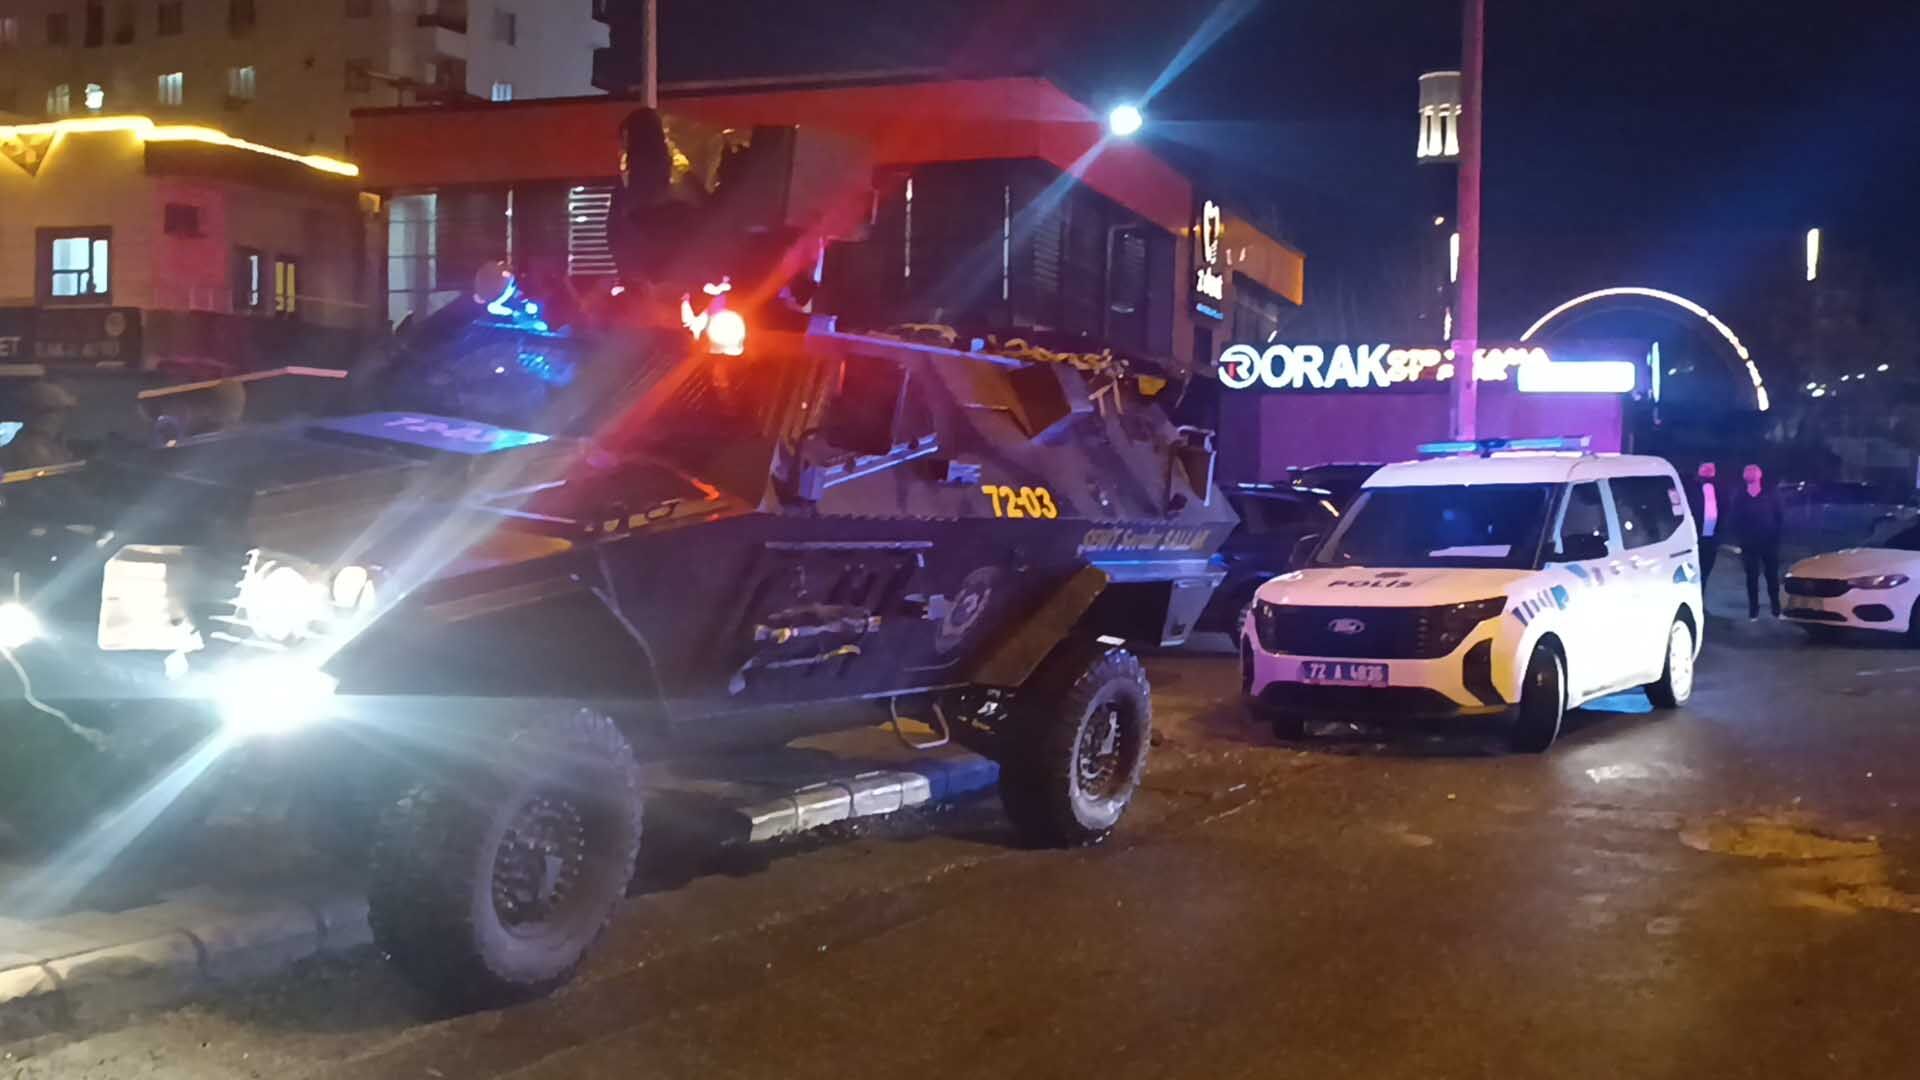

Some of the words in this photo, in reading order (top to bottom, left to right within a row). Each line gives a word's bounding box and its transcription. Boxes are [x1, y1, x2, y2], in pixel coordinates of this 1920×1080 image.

[1261, 343, 1391, 388] ORAK
[981, 485, 1058, 519] 72-03
[1310, 663, 1327, 679] 72
[1334, 664, 1342, 679] A
